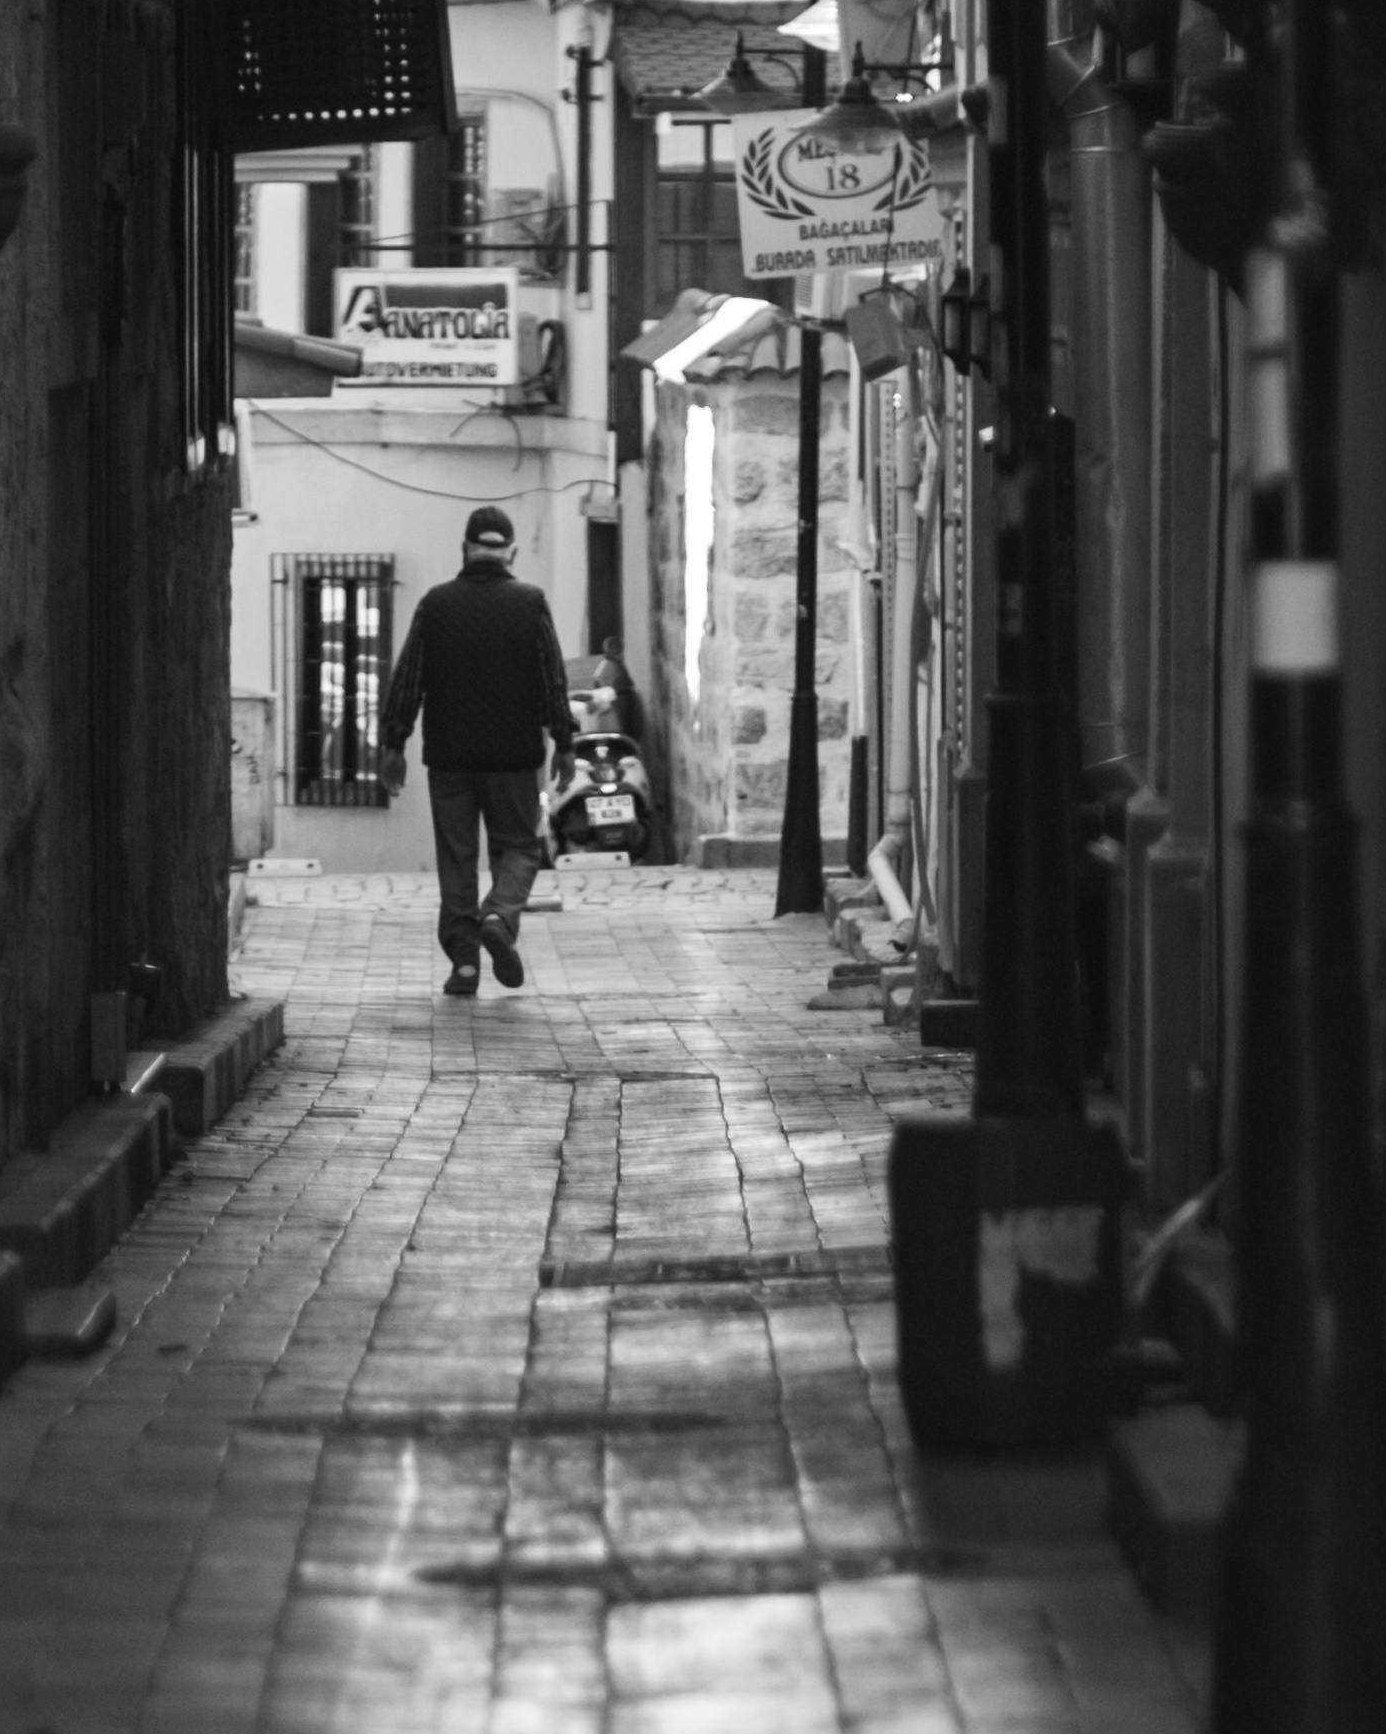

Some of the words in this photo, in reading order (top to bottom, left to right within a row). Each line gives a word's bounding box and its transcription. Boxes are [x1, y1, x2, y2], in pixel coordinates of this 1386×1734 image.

[826, 163, 861, 190] 18
[755, 249, 816, 272] BURADA
[362, 361, 498, 378] UTOVERMIETUNG
